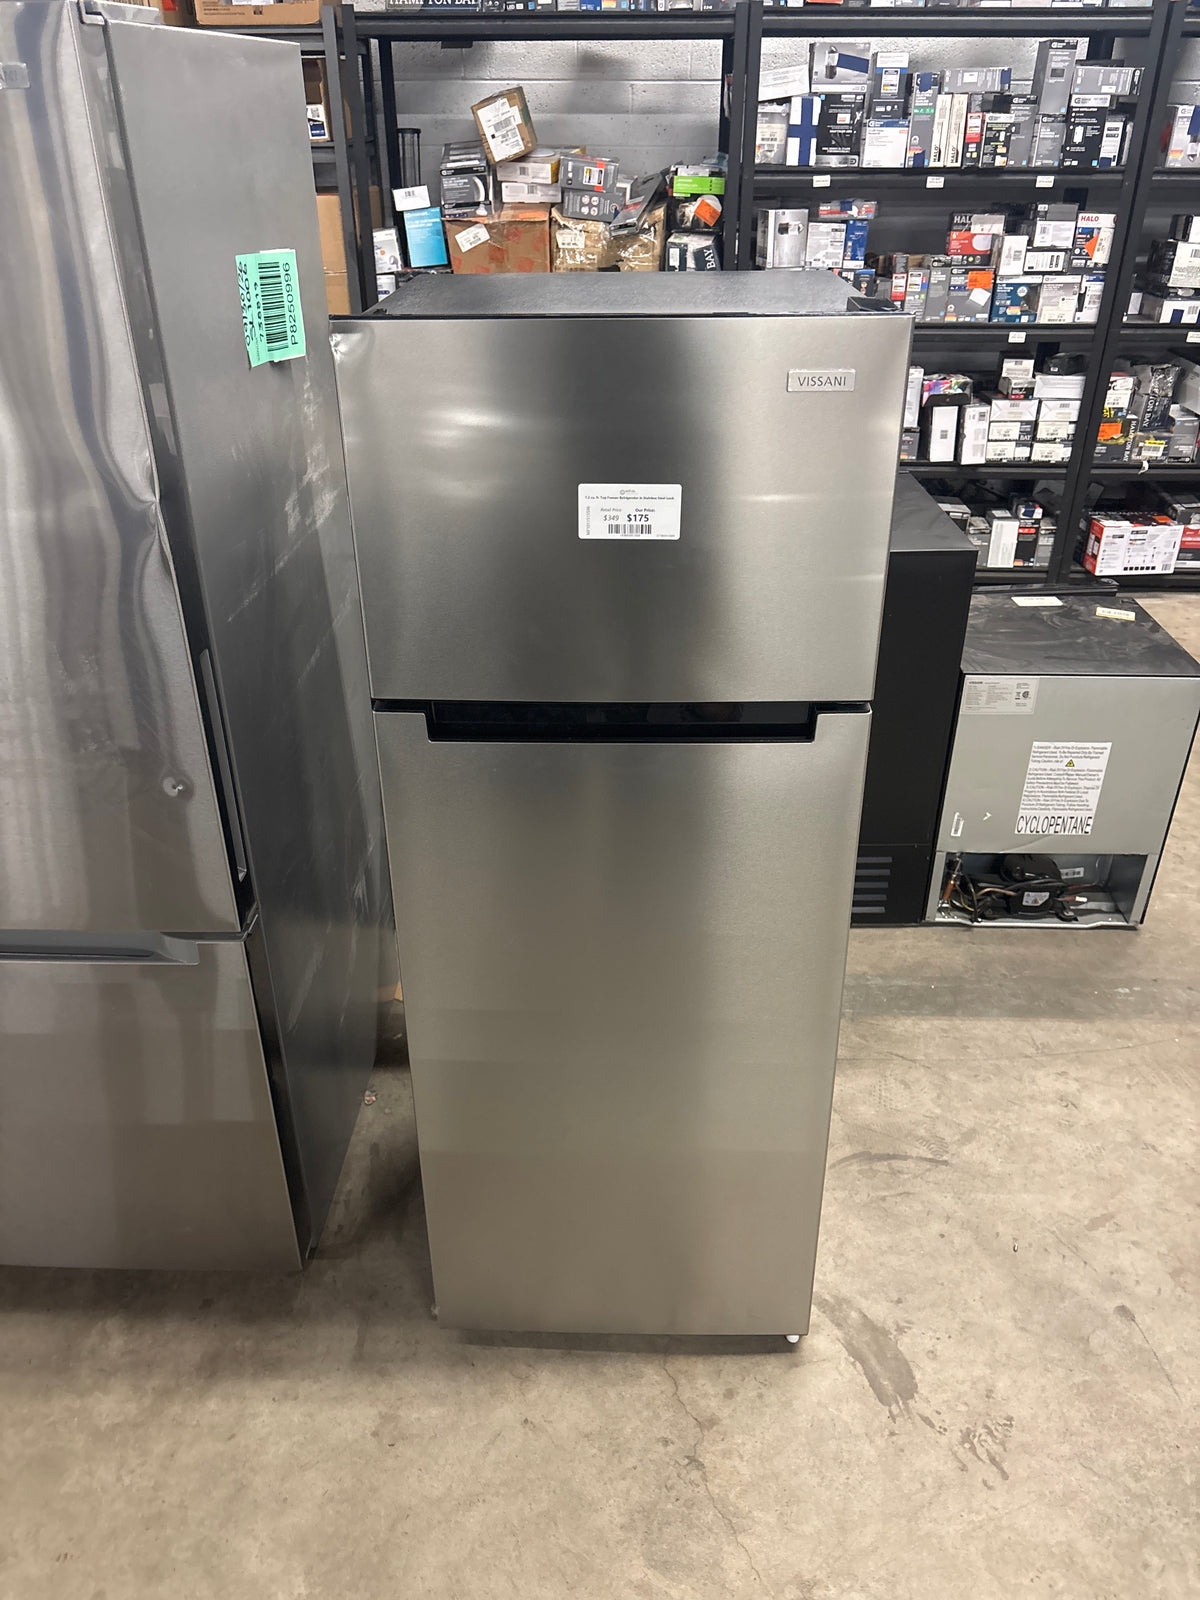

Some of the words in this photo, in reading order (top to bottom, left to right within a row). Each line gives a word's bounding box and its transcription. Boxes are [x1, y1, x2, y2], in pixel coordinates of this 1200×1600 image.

[953, 215, 974, 224] HAL
[704, 249, 716, 270] BAY
[282, 261, 299, 346] P8250996
[798, 376, 847, 387] VISSANI
[627, 513, 650, 523] $175
[1016, 815, 1093, 834] CYCLOPENTANE
